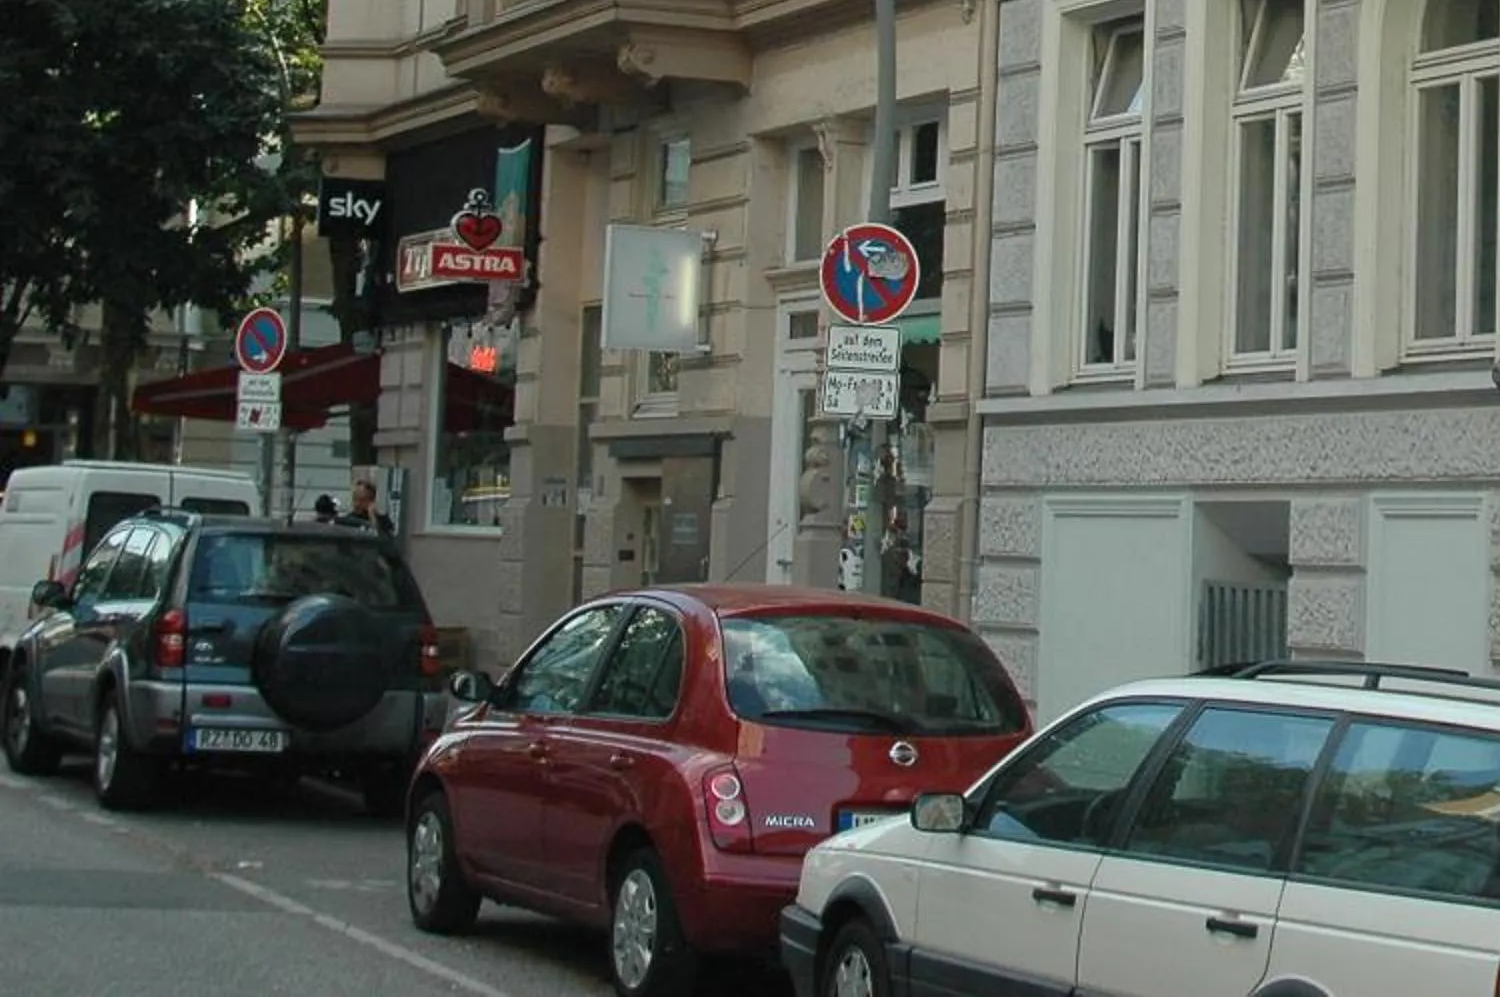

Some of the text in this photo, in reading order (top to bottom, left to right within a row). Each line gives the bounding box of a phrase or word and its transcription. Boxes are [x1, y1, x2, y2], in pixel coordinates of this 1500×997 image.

[329, 190, 382, 226] sky
[438, 253, 515, 273] ASTRA
[765, 815, 815, 827] MICRA
